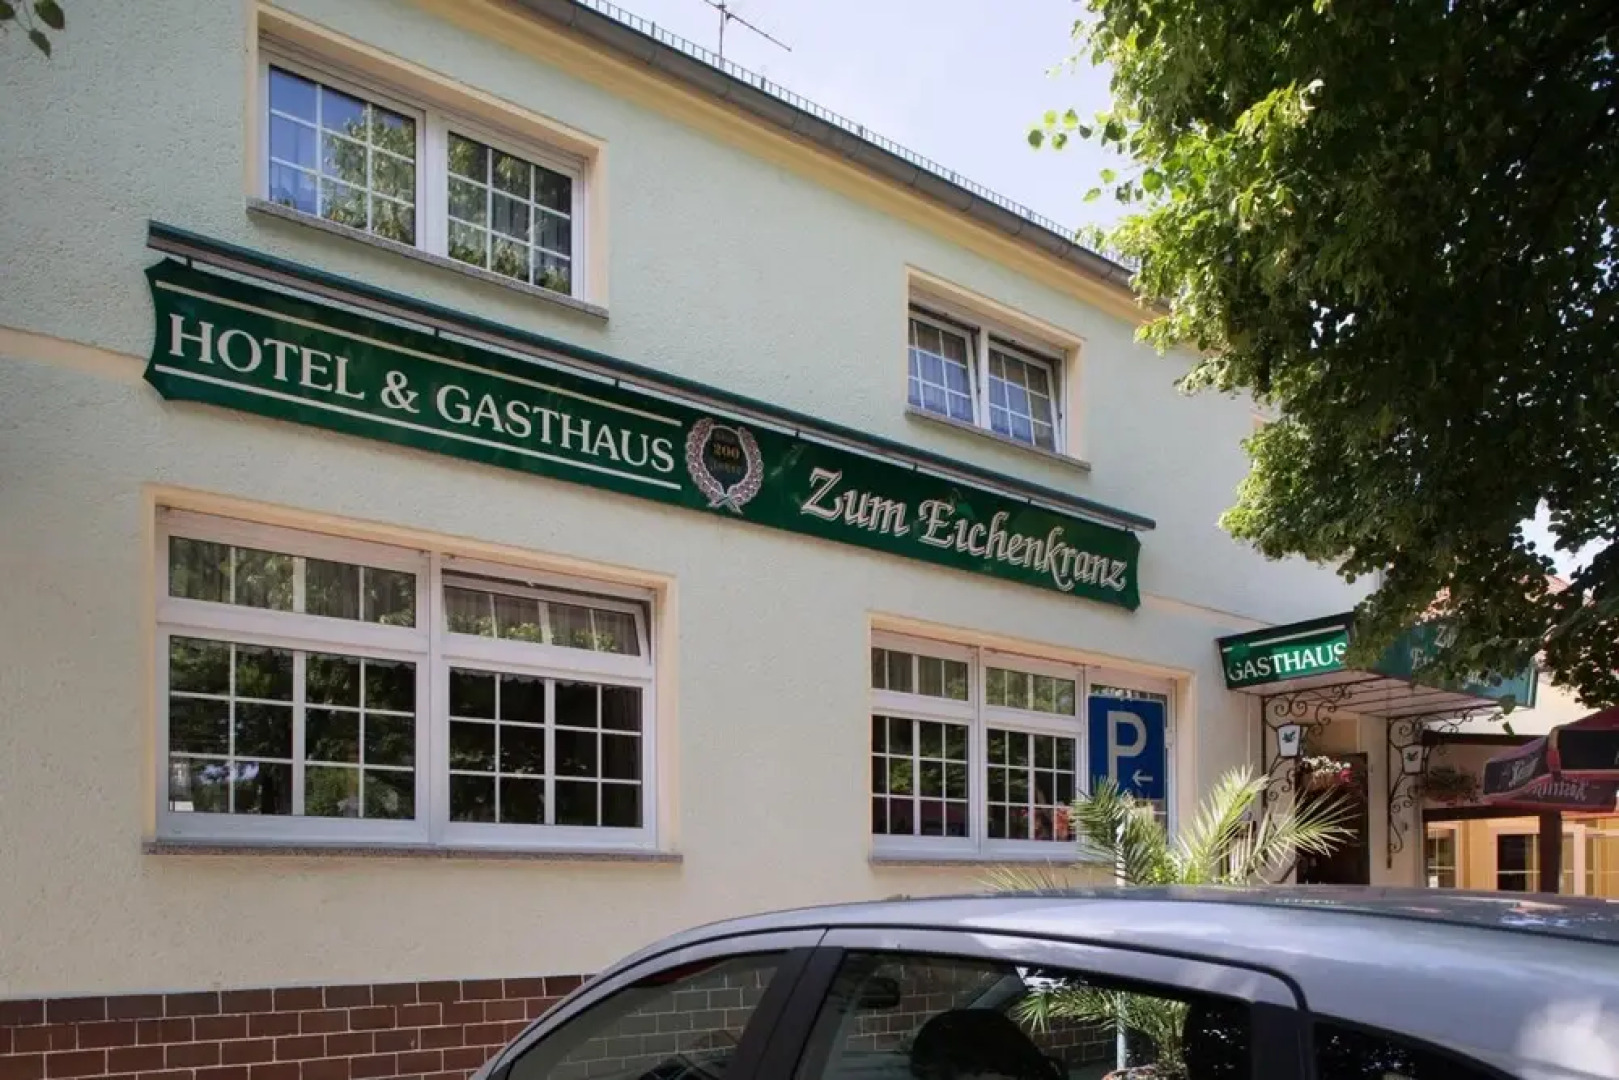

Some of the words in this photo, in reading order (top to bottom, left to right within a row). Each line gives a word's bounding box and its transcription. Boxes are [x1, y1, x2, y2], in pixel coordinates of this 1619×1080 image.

[169, 313, 365, 400] HOTEL
[381, 370, 420, 414] &
[436, 384, 675, 473] GASTHAUS
[801, 467, 910, 536] Zum
[918, 498, 1127, 592] Eichenkranz
[1228, 642, 1347, 681] GASTHAUS
[1106, 710, 1147, 787] P
